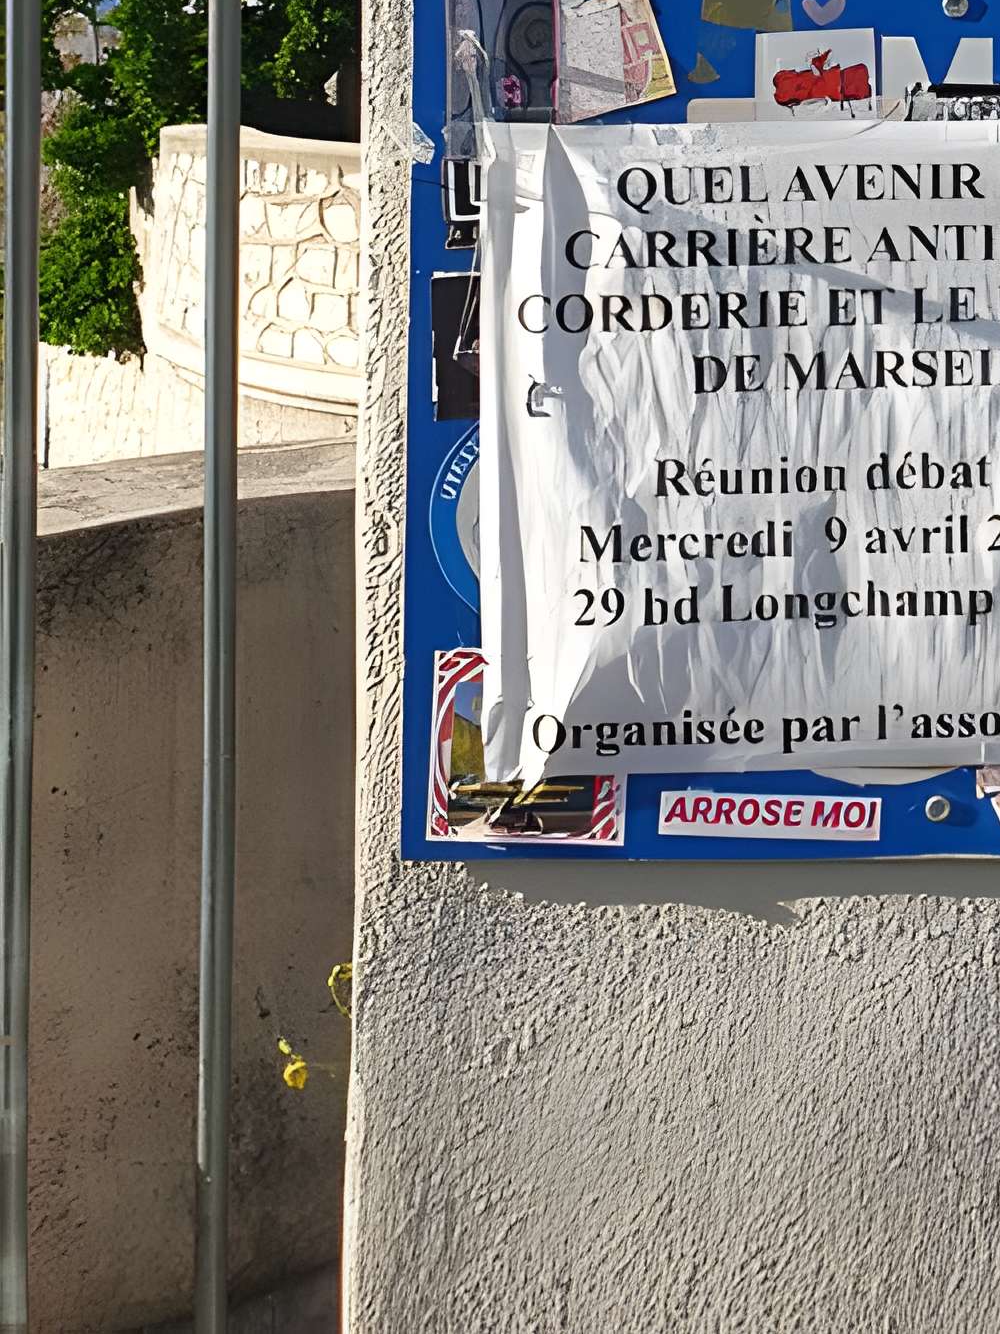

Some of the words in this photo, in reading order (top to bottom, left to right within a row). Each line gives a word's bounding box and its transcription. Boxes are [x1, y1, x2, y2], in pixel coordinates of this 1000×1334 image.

[616, 164, 768, 215] QUEL
[783, 163, 986, 202] AVENIR
[564, 213, 852, 270] CARRIÈRE
[517, 289, 808, 334] CORDERIE
[829, 286, 895, 330] ET
[914, 286, 976, 324] LE
[693, 353, 764, 394] DE
[655, 456, 846, 498] Réunion
[867, 451, 992, 491] débat
[580, 520, 793, 563] Mercredi
[825, 516, 848, 554] 9
[865, 513, 969, 555] avril
[574, 587, 626, 627] 29
[644, 587, 700, 626] bd
[721, 580, 993, 628] Longchamp
[533, 706, 765, 756] Organisée
[782, 715, 860, 754] par
[664, 797, 804, 826] ARROSE
[810, 801, 878, 828] MOI
